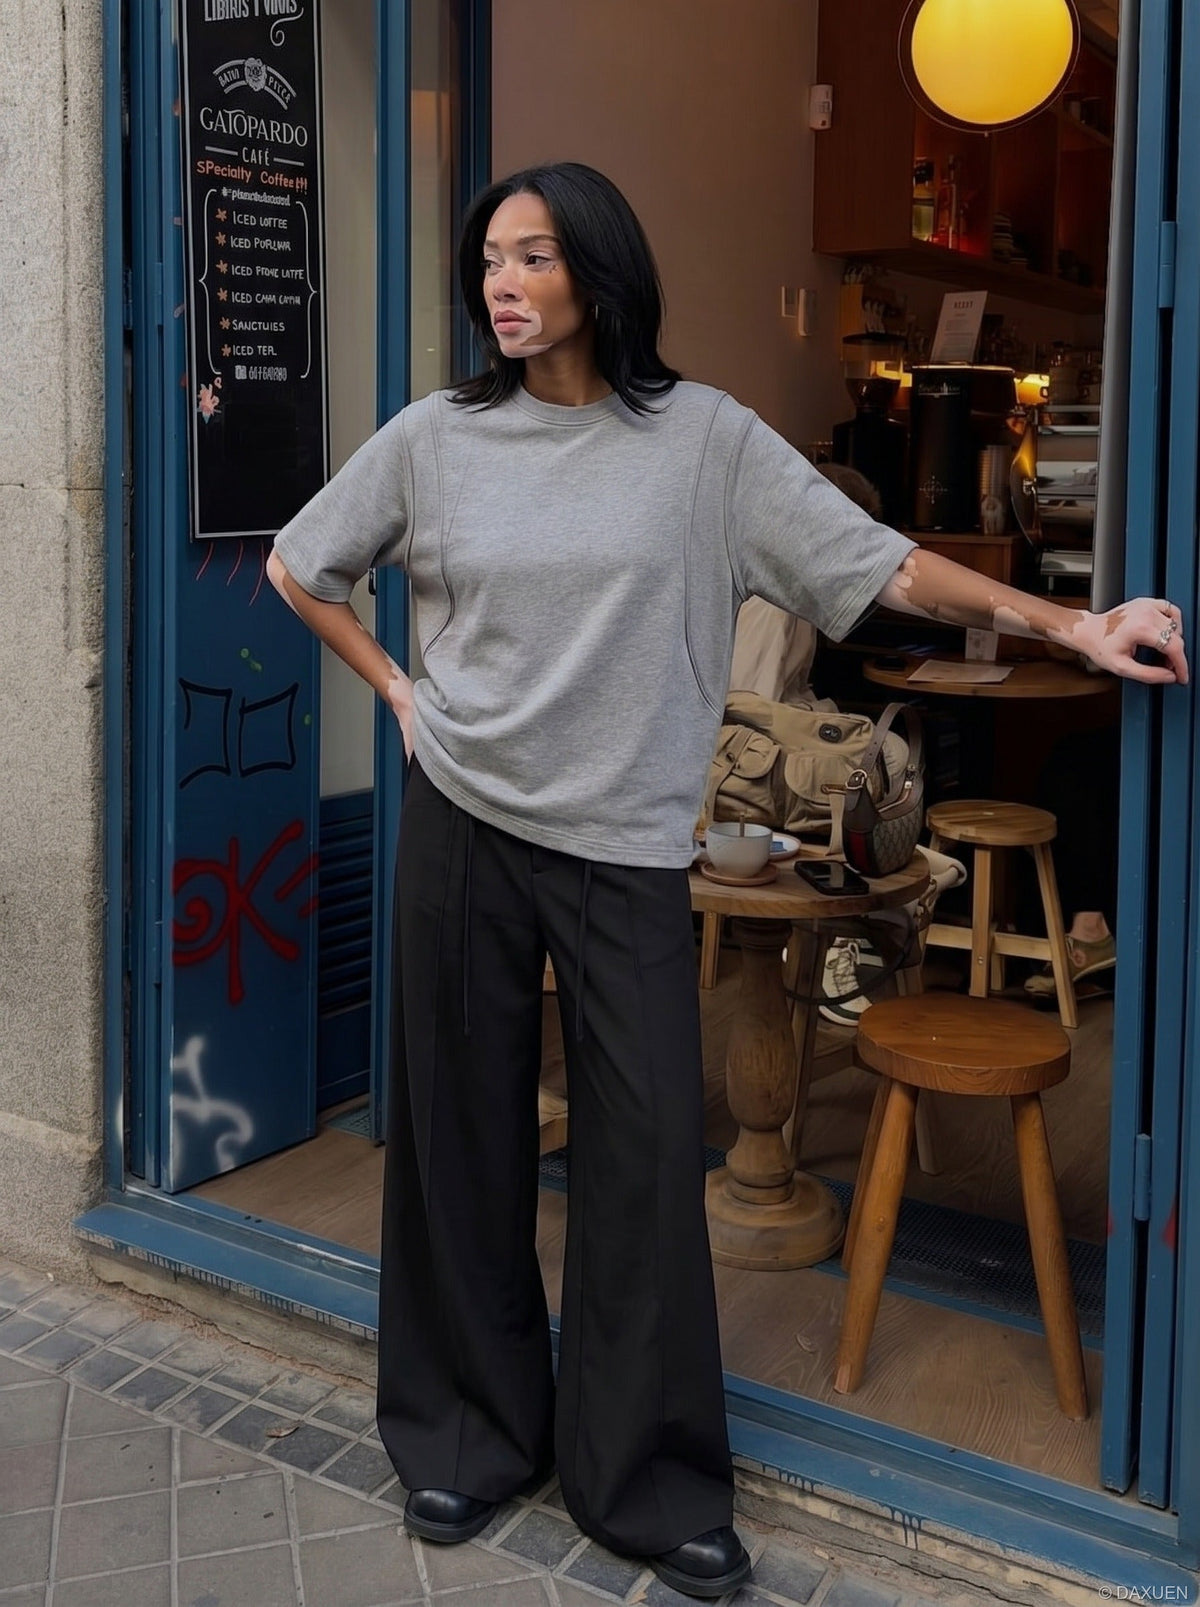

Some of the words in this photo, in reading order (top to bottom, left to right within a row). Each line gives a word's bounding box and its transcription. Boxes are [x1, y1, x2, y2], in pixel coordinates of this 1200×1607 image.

[200, 106, 308, 147] GATOPARDO
[232, 210, 257, 226] ICED
[230, 235, 251, 249] ICED
[231, 264, 253, 277] ICED
[231, 291, 253, 304] ICED
[232, 344, 254, 356] ICED
